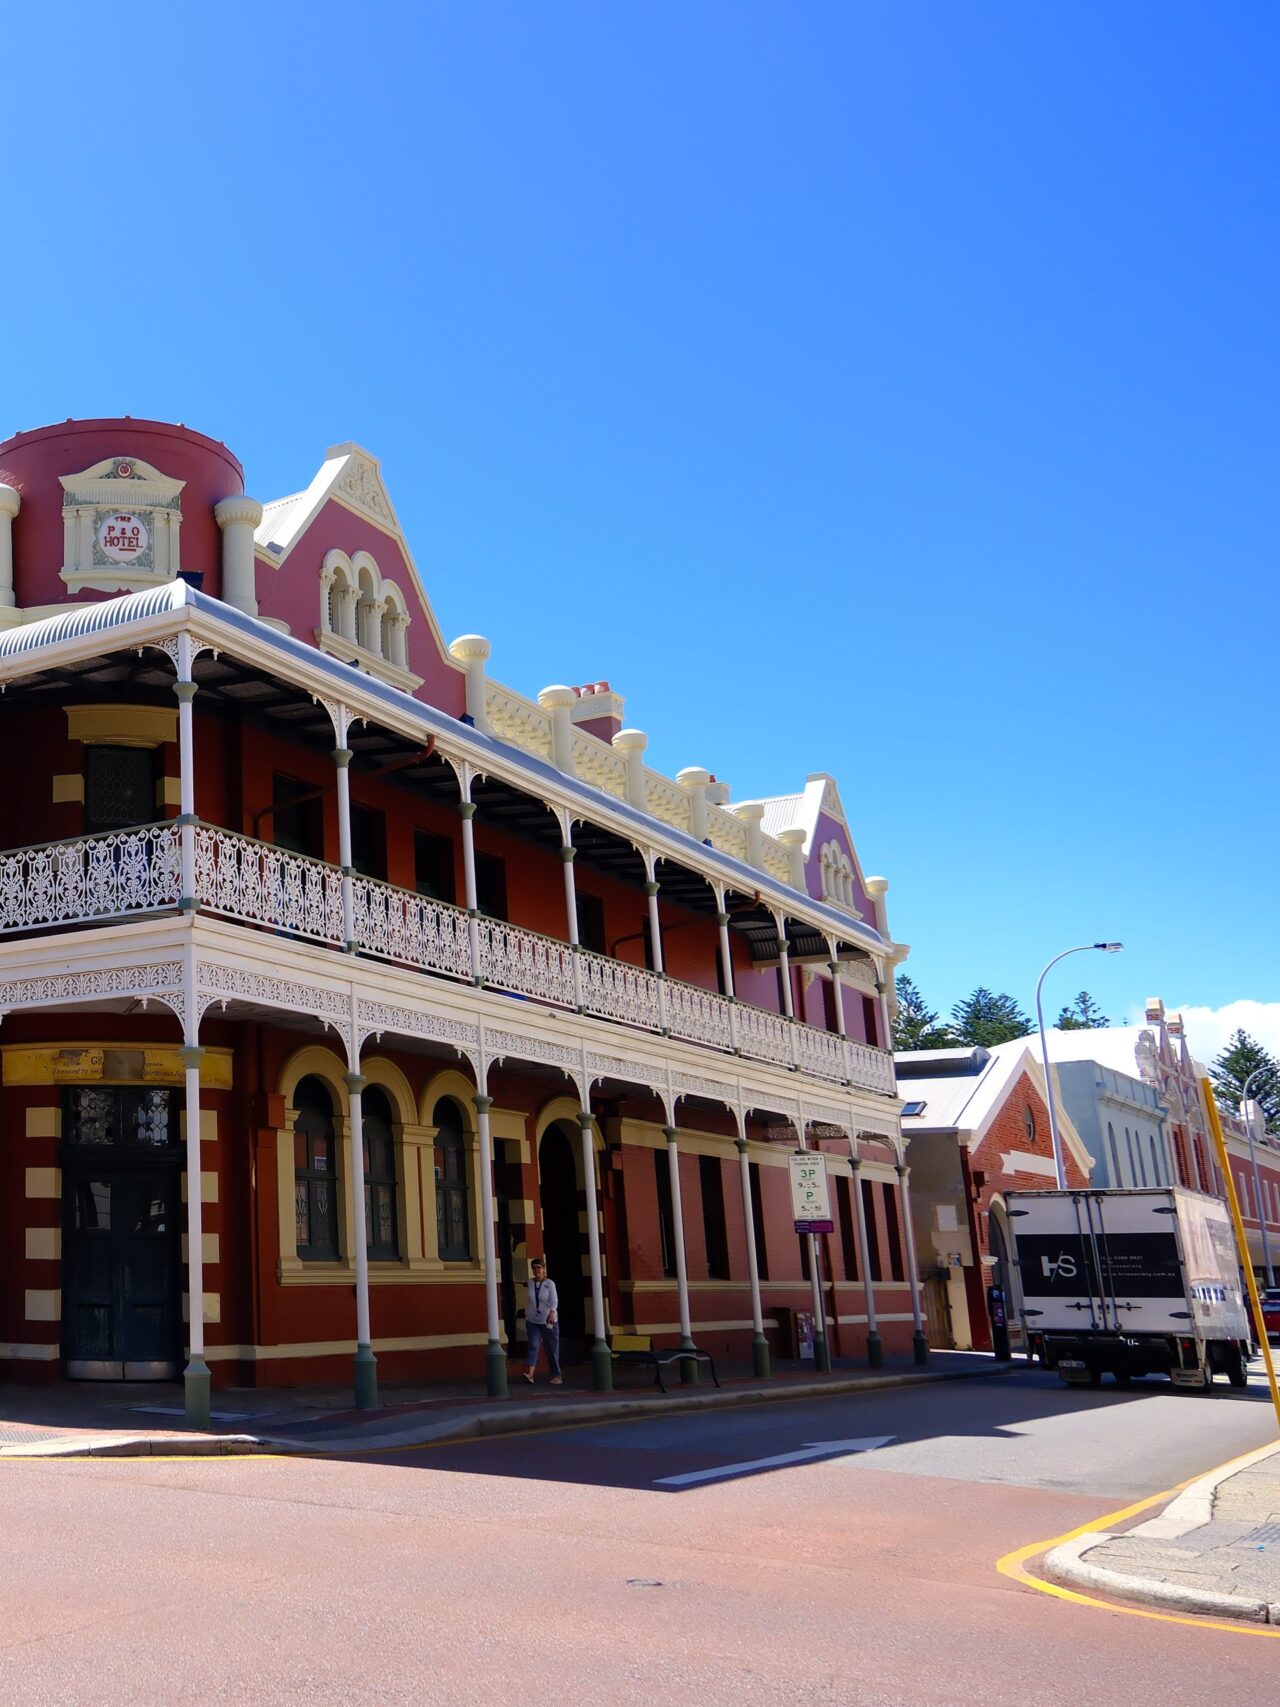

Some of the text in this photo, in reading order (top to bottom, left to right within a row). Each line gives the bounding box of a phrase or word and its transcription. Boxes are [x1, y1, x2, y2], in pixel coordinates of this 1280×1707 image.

[107, 526, 116, 536] P
[131, 527, 140, 536] O
[104, 536, 143, 548] HOTEL
[800, 1169, 816, 1178] 3P
[806, 1191, 814, 1200] P
